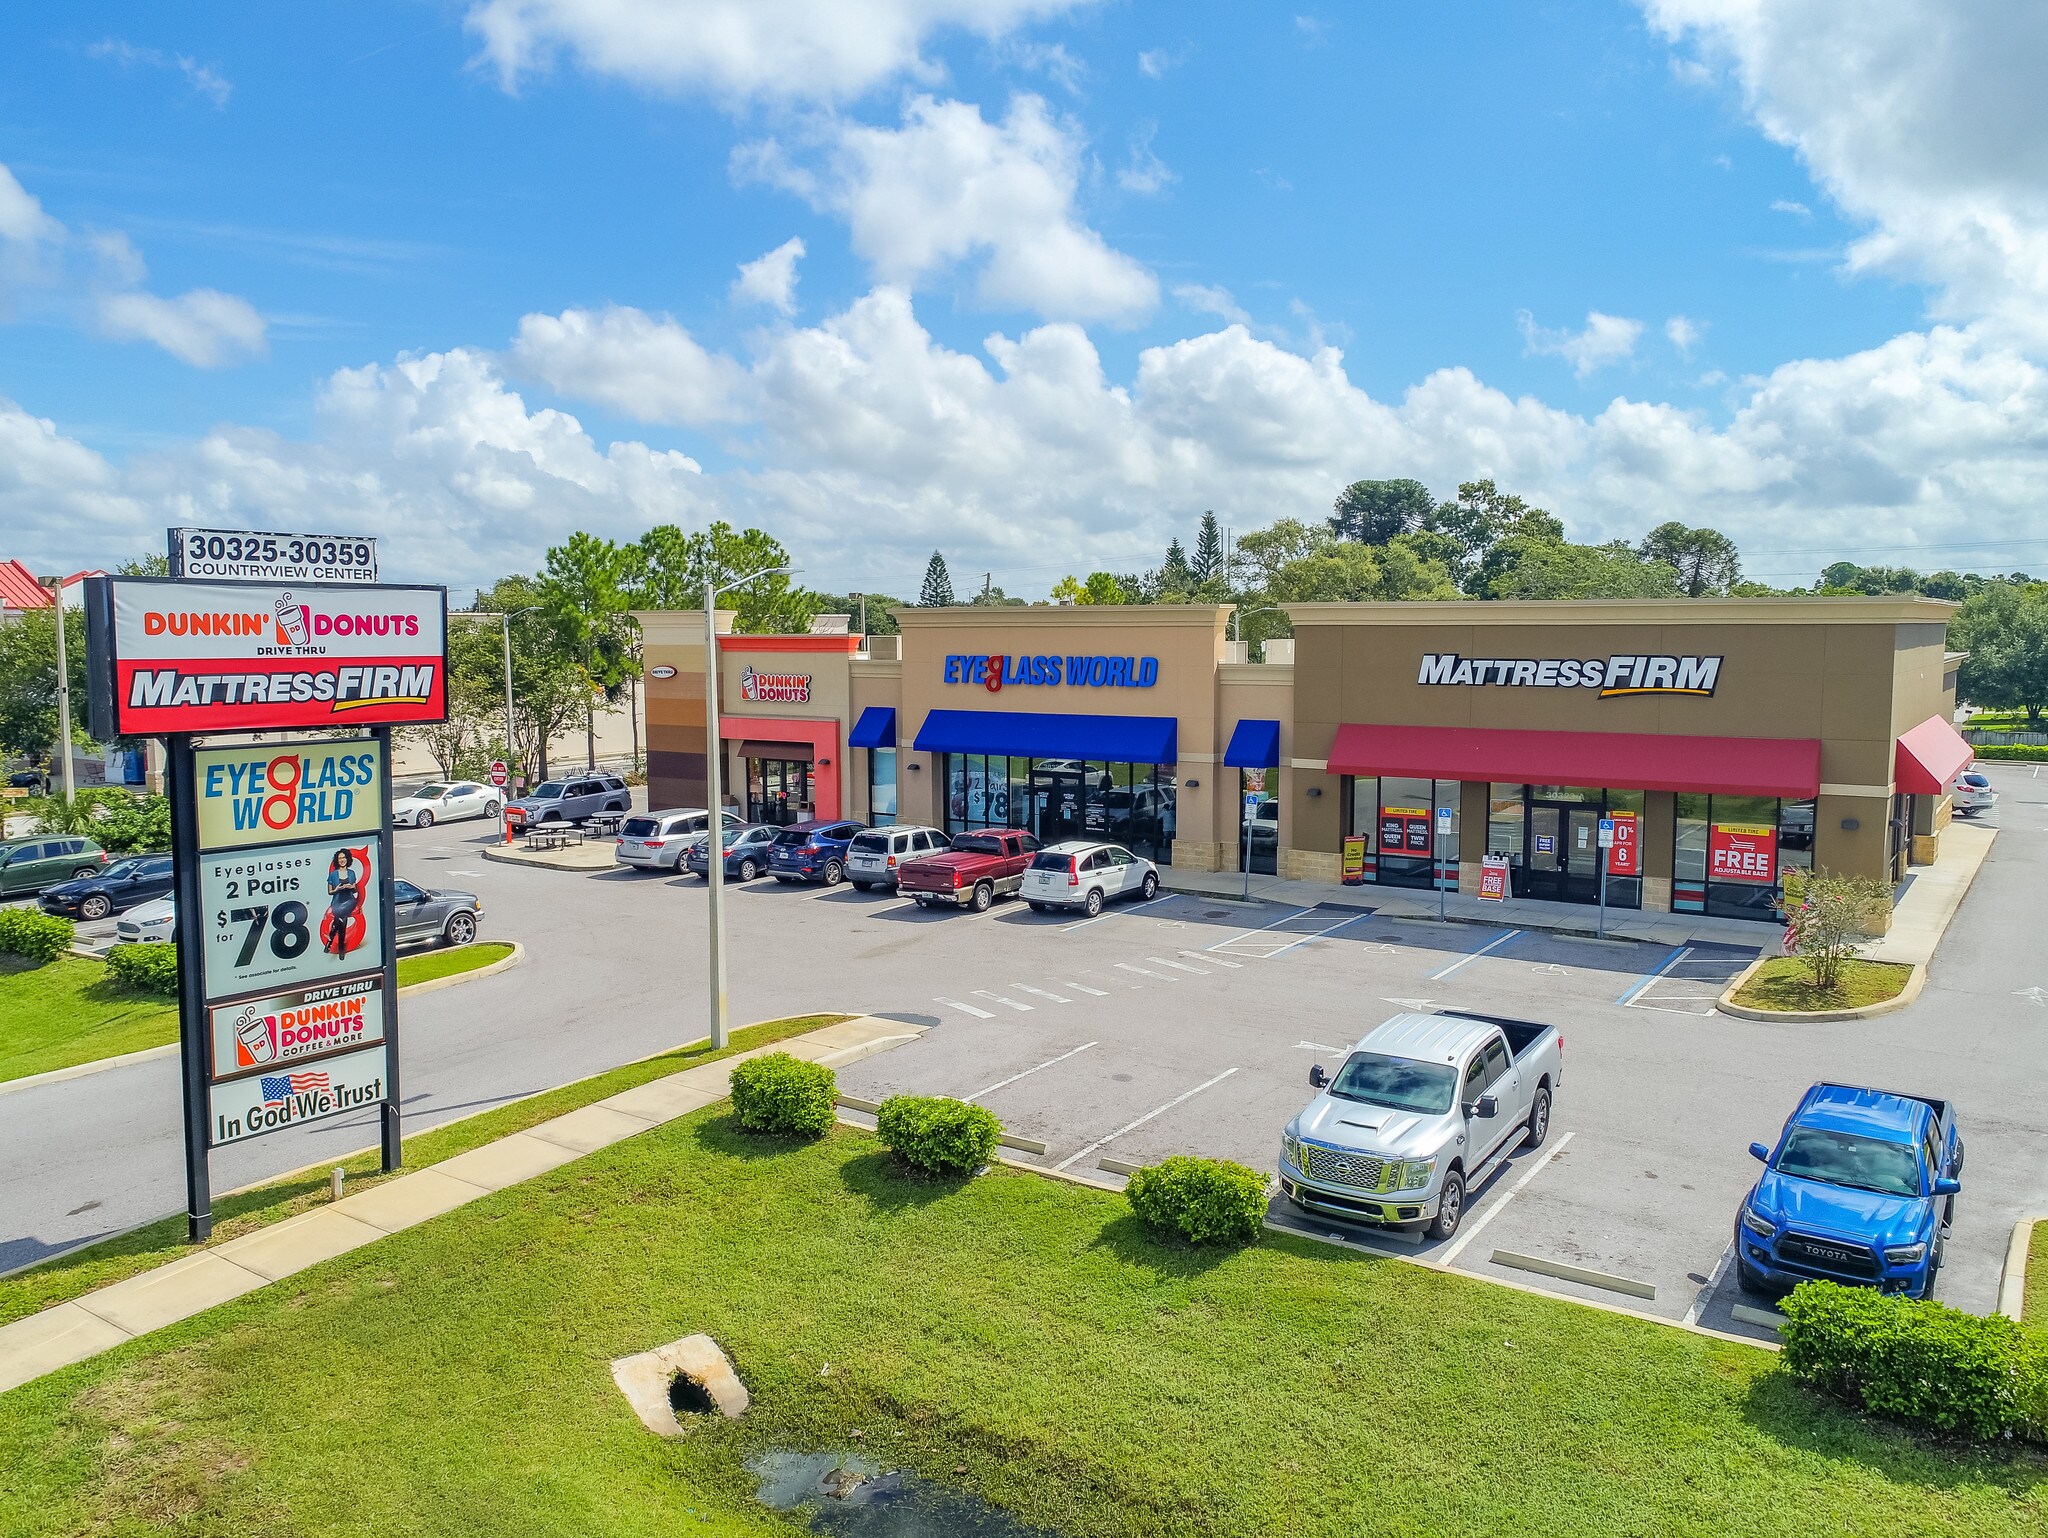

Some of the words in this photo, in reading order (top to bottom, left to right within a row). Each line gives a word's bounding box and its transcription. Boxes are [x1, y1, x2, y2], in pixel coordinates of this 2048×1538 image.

[189, 535, 370, 566] 30325-30359
[189, 563, 308, 578] COUNTRYVIEW
[313, 567, 373, 580] CENTER
[143, 612, 270, 636] DUNKIN'
[314, 614, 419, 637] DONUTS
[257, 647, 292, 655] DRIVE
[295, 646, 326, 655] THRU
[759, 674, 810, 688] DUNKIN'
[1066, 656, 1159, 688] WORLD
[759, 688, 807, 701] DONUTS
[232, 789, 354, 831] WORLD
[1618, 825, 1634, 841] 0%
[1618, 847, 1627, 861] 6
[1714, 849, 1769, 871] FREE
[214, 858, 312, 878] Eyeglasses
[226, 881, 239, 899] 2
[247, 876, 300, 897] Pairs
[1482, 885, 1501, 893] BASE
[1483, 876, 1502, 885] FREE
[216, 933, 234, 943] for
[304, 986, 340, 1003] DRIVE
[341, 980, 374, 995] THRU
[280, 996, 367, 1030] DUNKIN'
[281, 1015, 364, 1047] DONUTS
[282, 1041, 324, 1057] COFFEE
[333, 1032, 363, 1046] MORE
[218, 1114, 241, 1140] In
[246, 1096, 292, 1132] God
[295, 1090, 331, 1119] We
[333, 1078, 382, 1109] Trust
[1805, 1245, 1848, 1261] TOYOTA
